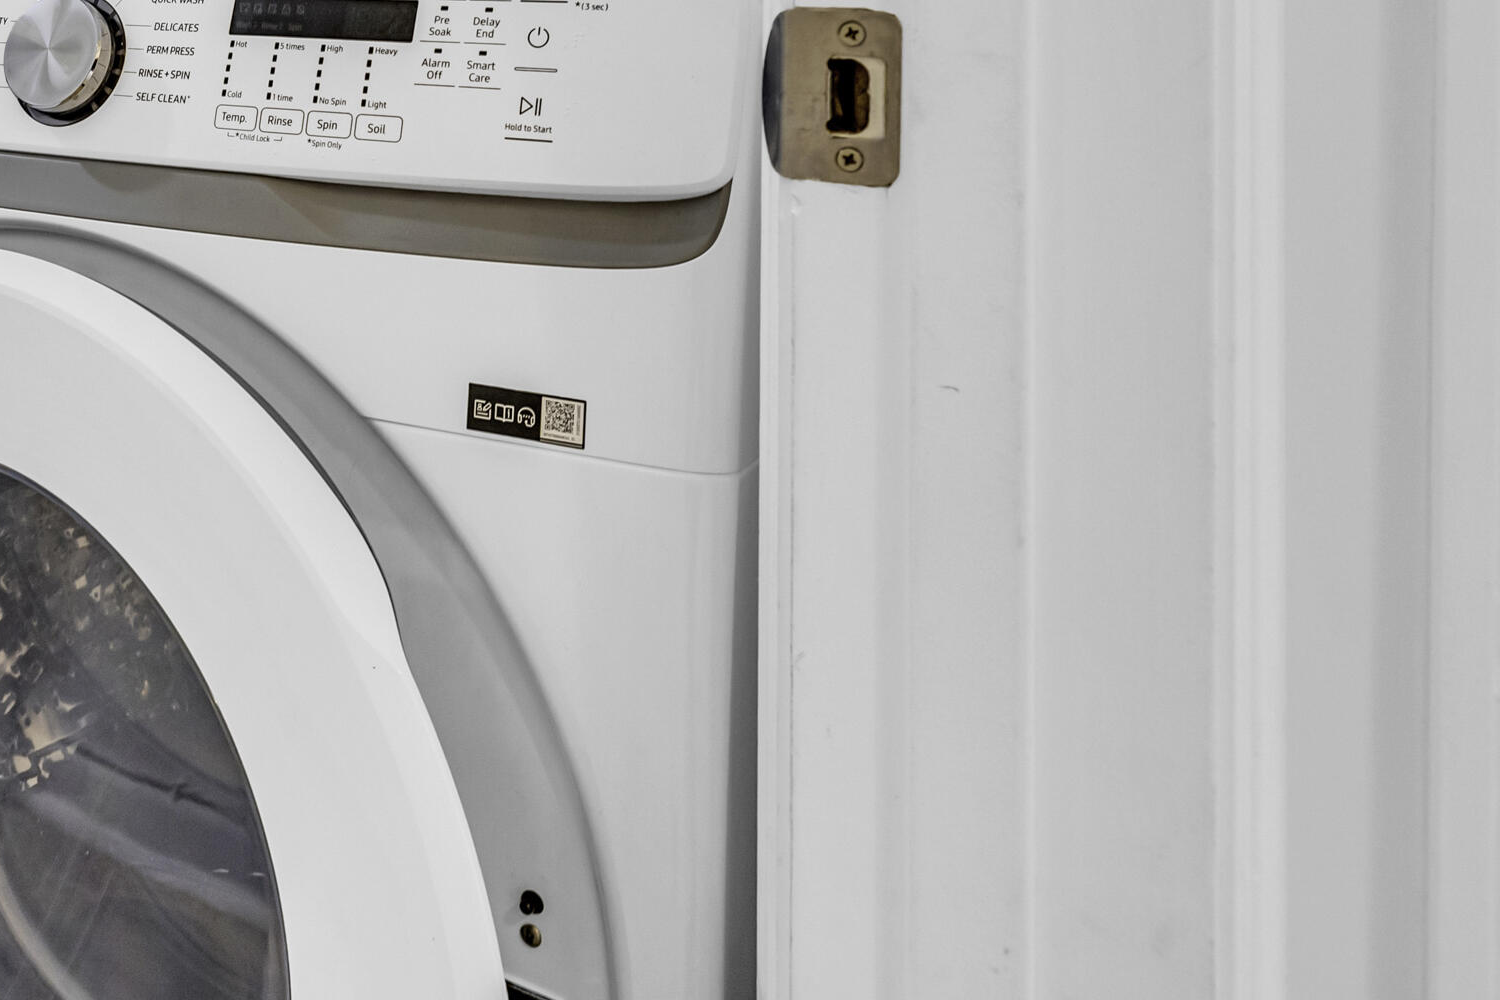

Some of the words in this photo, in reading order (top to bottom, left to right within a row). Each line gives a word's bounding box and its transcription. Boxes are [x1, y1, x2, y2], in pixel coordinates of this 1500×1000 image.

[591, 3, 609, 11] sec)
[434, 15, 450, 25] Pre
[473, 16, 501, 29] Delay
[153, 22, 199, 32] DELICATES
[429, 27, 451, 37] Soak
[476, 29, 494, 39] End
[146, 45, 169, 55] PERM
[170, 46, 195, 56] PRESS
[285, 43, 305, 51] times
[326, 45, 344, 54] High
[375, 47, 398, 56] Heavy
[421, 58, 451, 68] Alarm
[466, 60, 496, 71] Smart
[138, 68, 164, 79] RINSE
[170, 70, 191, 80] SPIN
[426, 70, 443, 80] Off
[468, 72, 491, 83] Care
[136, 91, 157, 102] SELF
[227, 90, 243, 99] Cold
[277, 93, 294, 102] time
[330, 97, 347, 106] Spin
[367, 101, 387, 110] Light
[222, 111, 247, 124] Temp.
[267, 115, 293, 127] Rinse
[317, 119, 338, 131] Spin
[367, 123, 386, 135] Soil
[504, 123, 523, 132] Hold
[523, 123, 532, 133] to
[533, 124, 553, 134] Start
